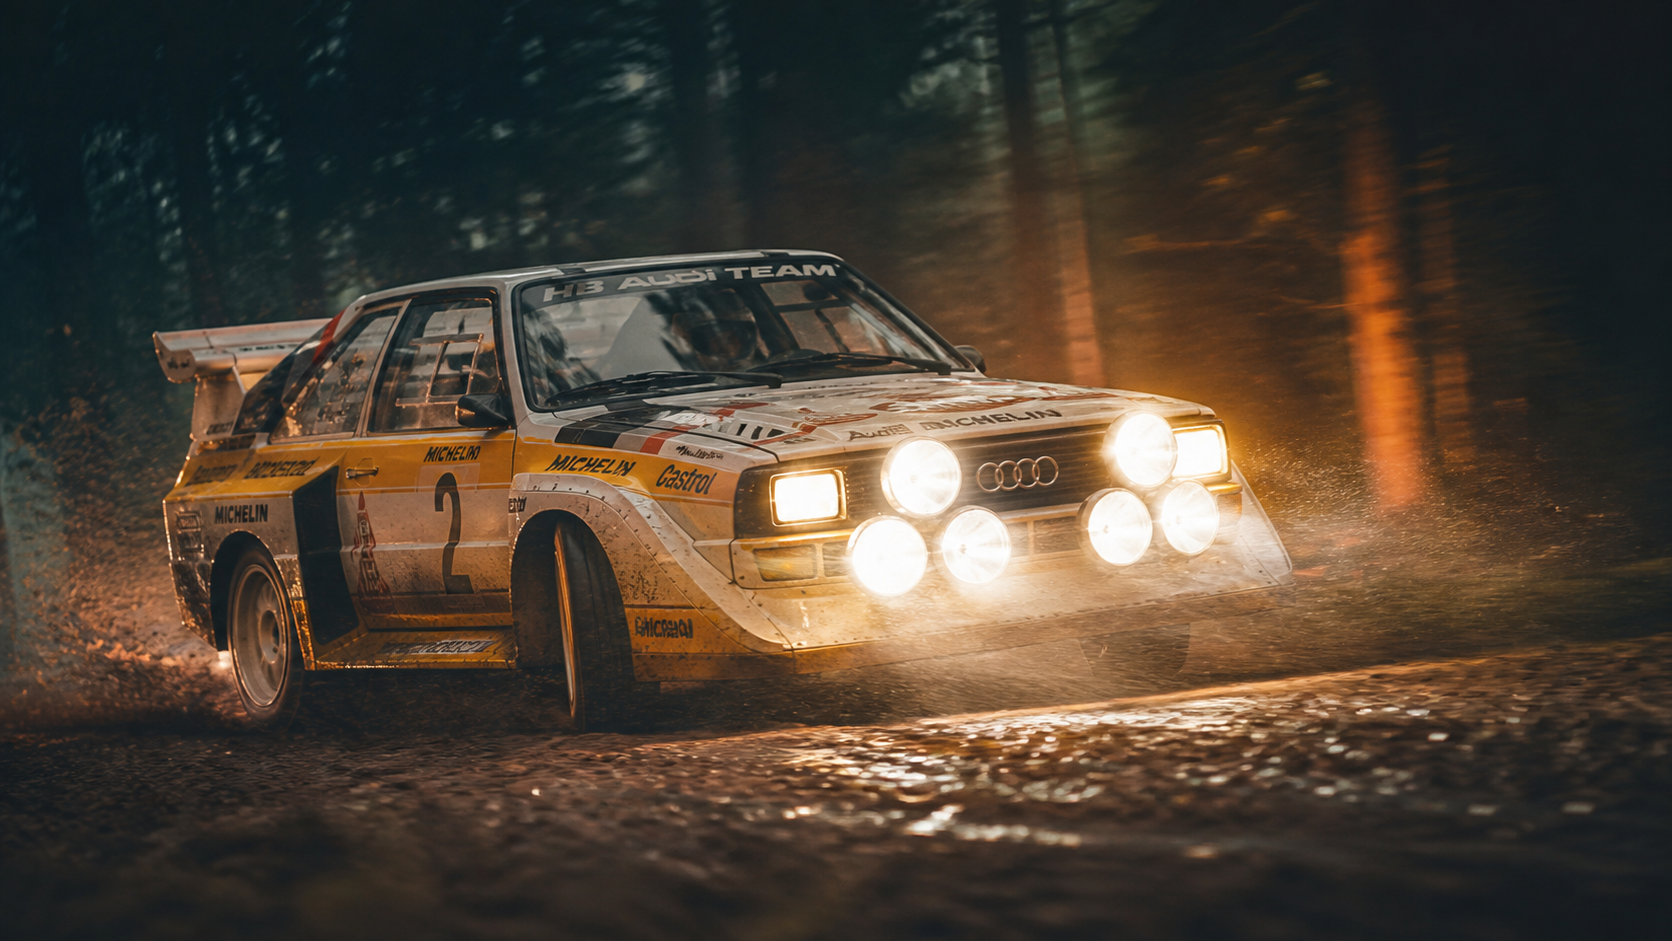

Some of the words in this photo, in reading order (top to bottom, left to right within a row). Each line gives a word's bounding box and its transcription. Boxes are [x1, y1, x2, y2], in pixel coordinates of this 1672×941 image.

[543, 281, 605, 302] HB
[724, 264, 838, 280] TEAM
[545, 454, 637, 477] MICHELIN
[655, 464, 717, 495] Castrol
[214, 504, 269, 525] MICHELIN
[434, 472, 475, 595] 2
